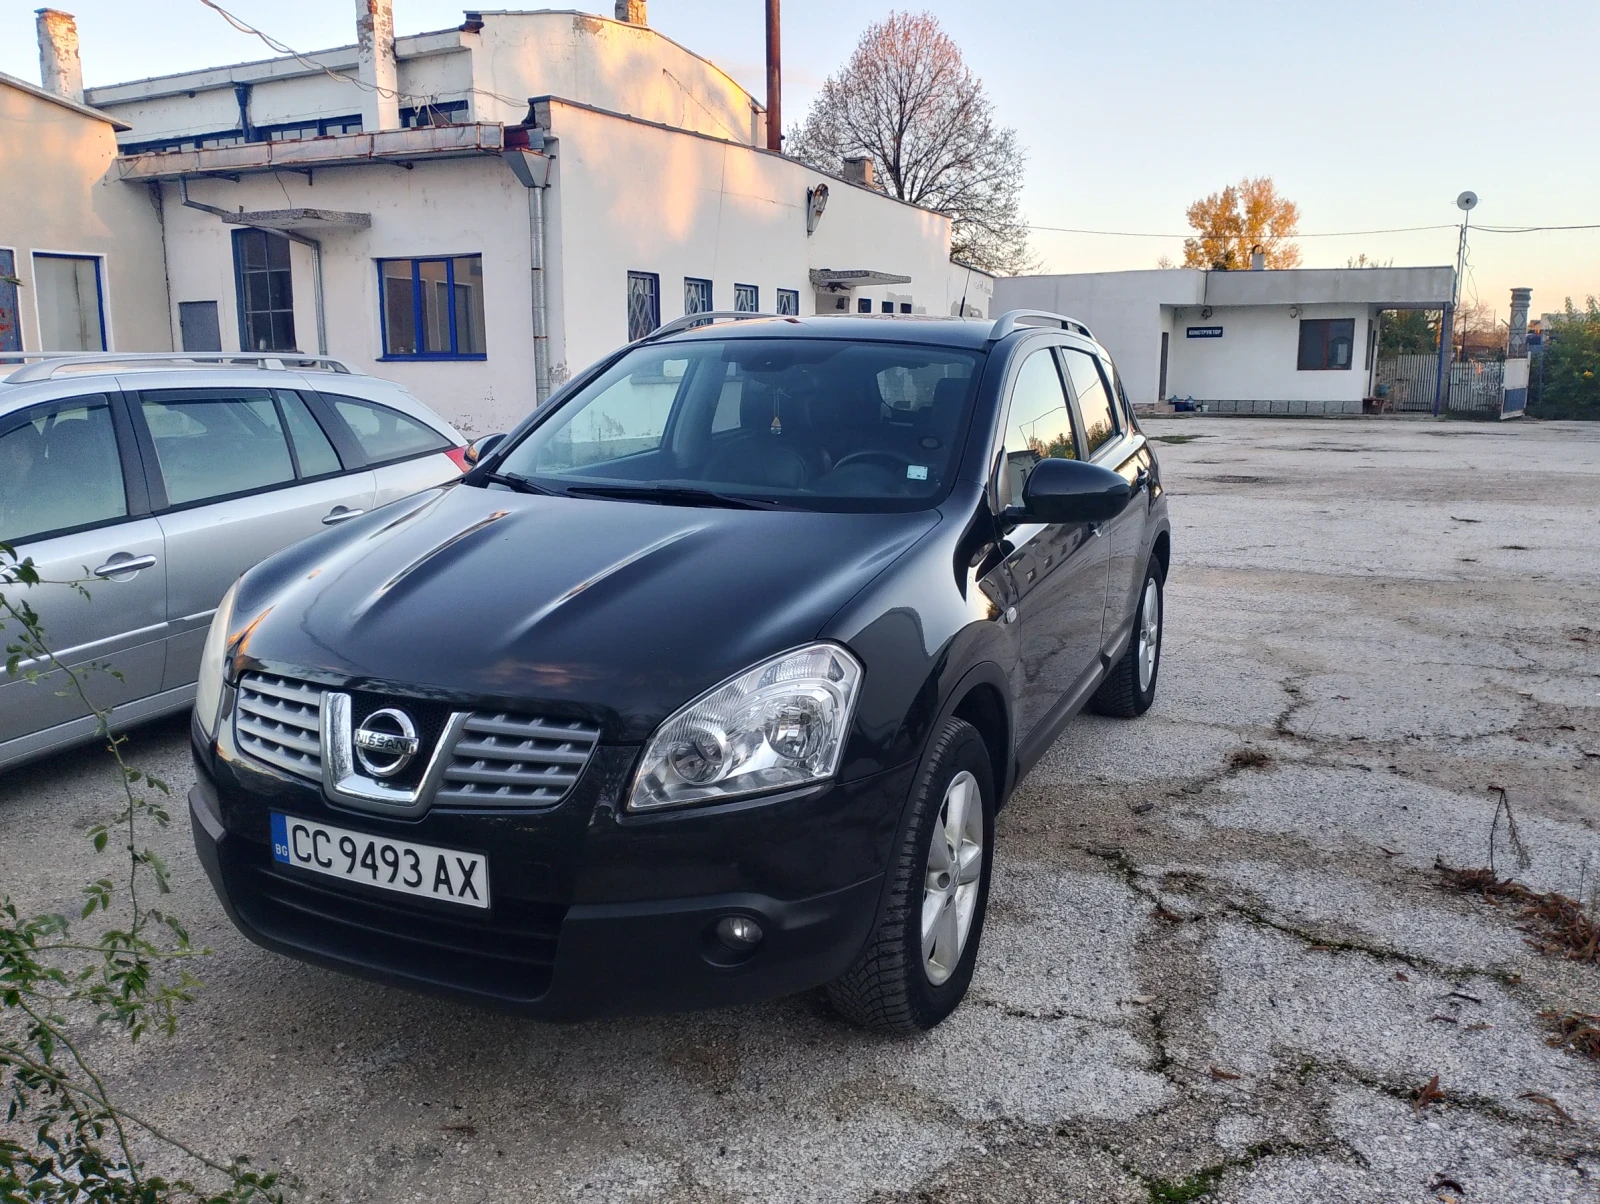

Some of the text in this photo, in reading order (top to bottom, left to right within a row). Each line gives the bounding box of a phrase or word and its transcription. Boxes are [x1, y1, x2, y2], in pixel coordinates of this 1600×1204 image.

[356, 731, 410, 752] NISSAN
[275, 843, 288, 857] BG
[291, 824, 480, 900] CC 9493 AX
